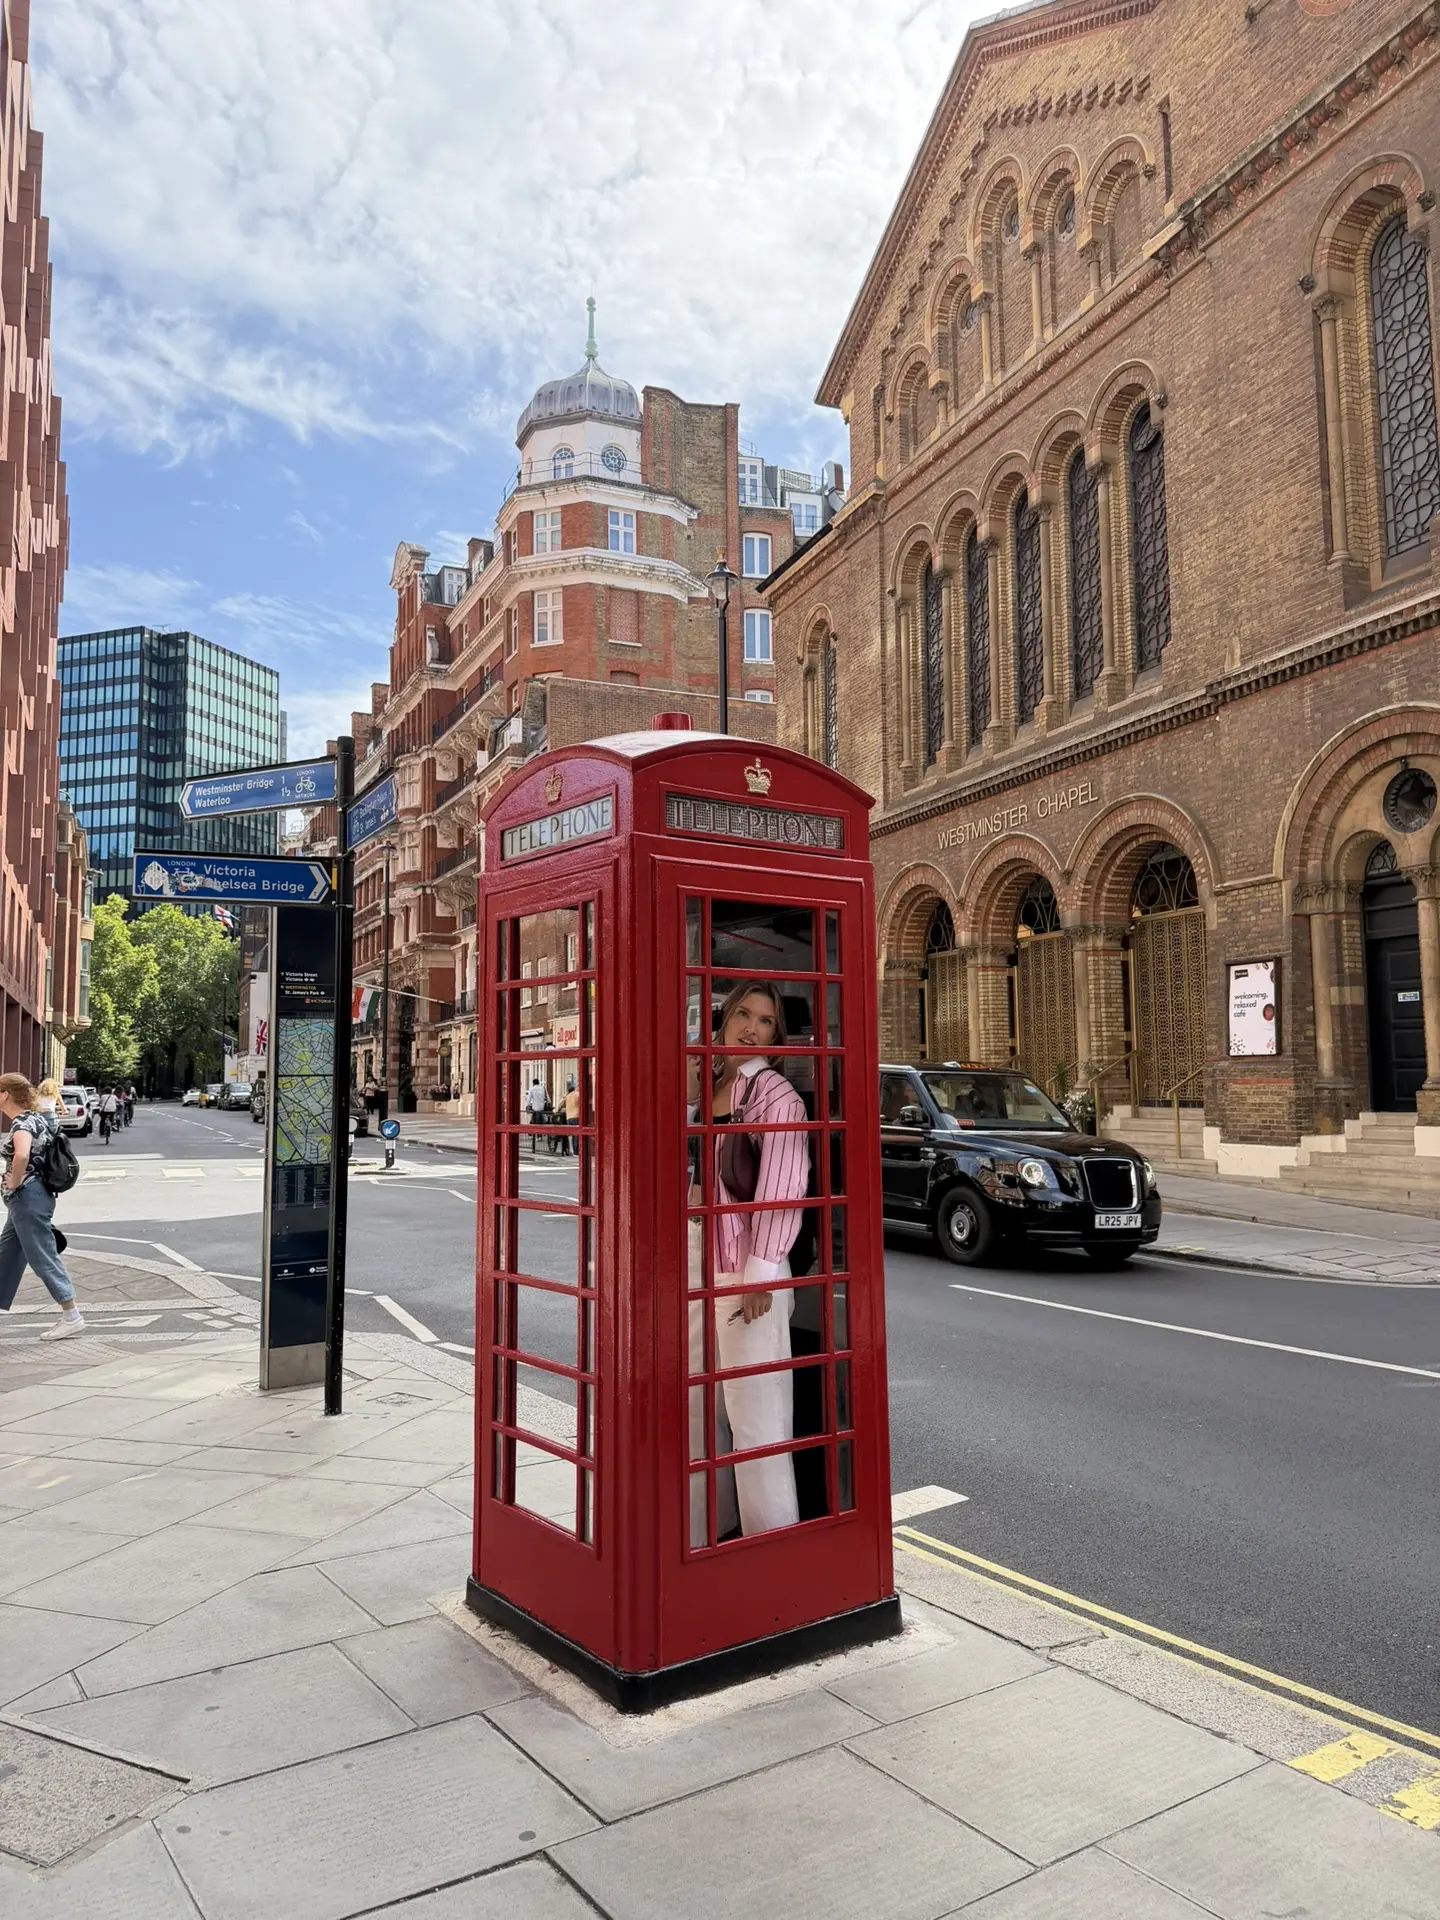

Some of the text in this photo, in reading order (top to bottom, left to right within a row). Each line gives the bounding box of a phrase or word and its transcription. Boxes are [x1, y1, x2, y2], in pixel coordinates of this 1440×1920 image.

[195, 775, 285, 796] Westminster Bridge 1
[194, 796, 231, 808] Waterloo
[937, 782, 1099, 850] WESTMINSTER CHAPEL
[507, 799, 610, 855] TELEPHONE
[672, 800, 837, 847] TELEPHONE
[203, 864, 256, 877] Victoria
[262, 880, 305, 894] Bridge
[1233, 1000, 1257, 1009] relaxed
[1233, 1009, 1247, 1018] café
[1098, 1215, 1139, 1226] LR25 JPV
